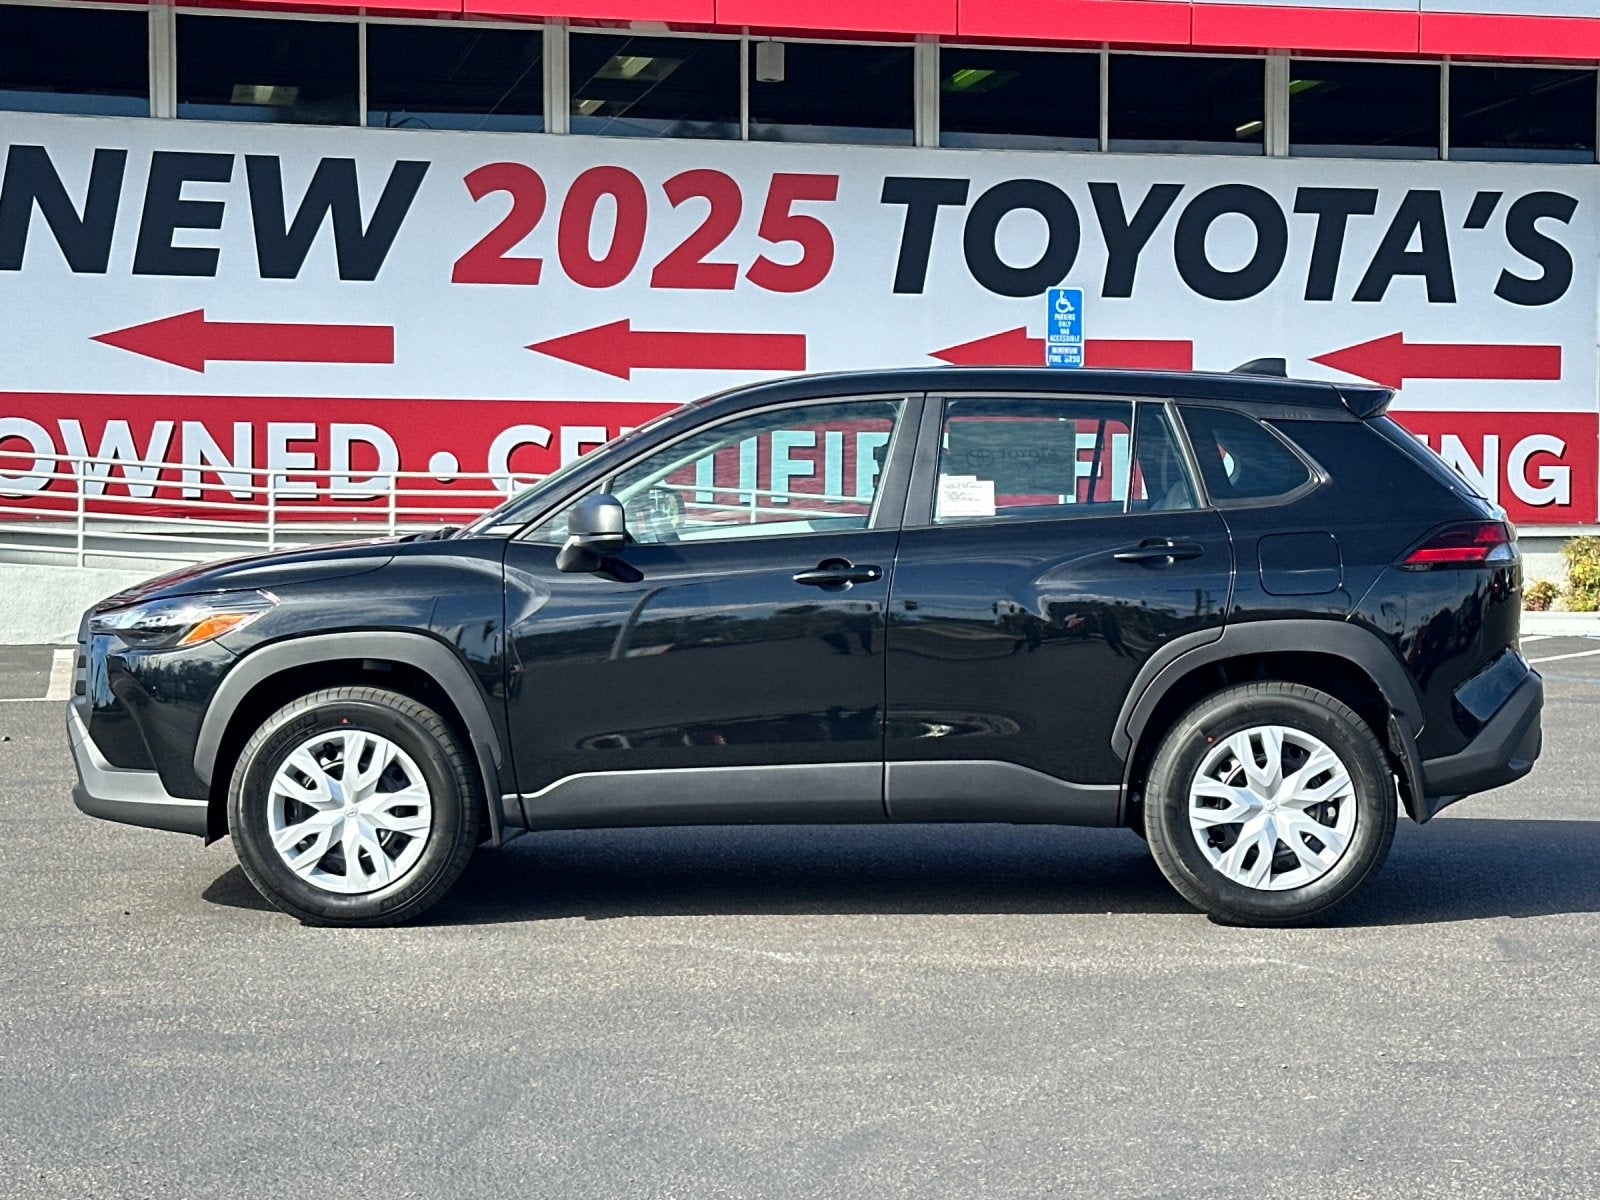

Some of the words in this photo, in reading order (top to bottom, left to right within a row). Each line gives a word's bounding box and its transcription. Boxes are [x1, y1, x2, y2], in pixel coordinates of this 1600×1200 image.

[0, 144, 431, 282] NEW
[451, 161, 840, 294] 2025
[880, 176, 1580, 307] TOYOTA'S
[1054, 313, 1076, 321] PARKING
[0, 417, 399, 499] OWNED
